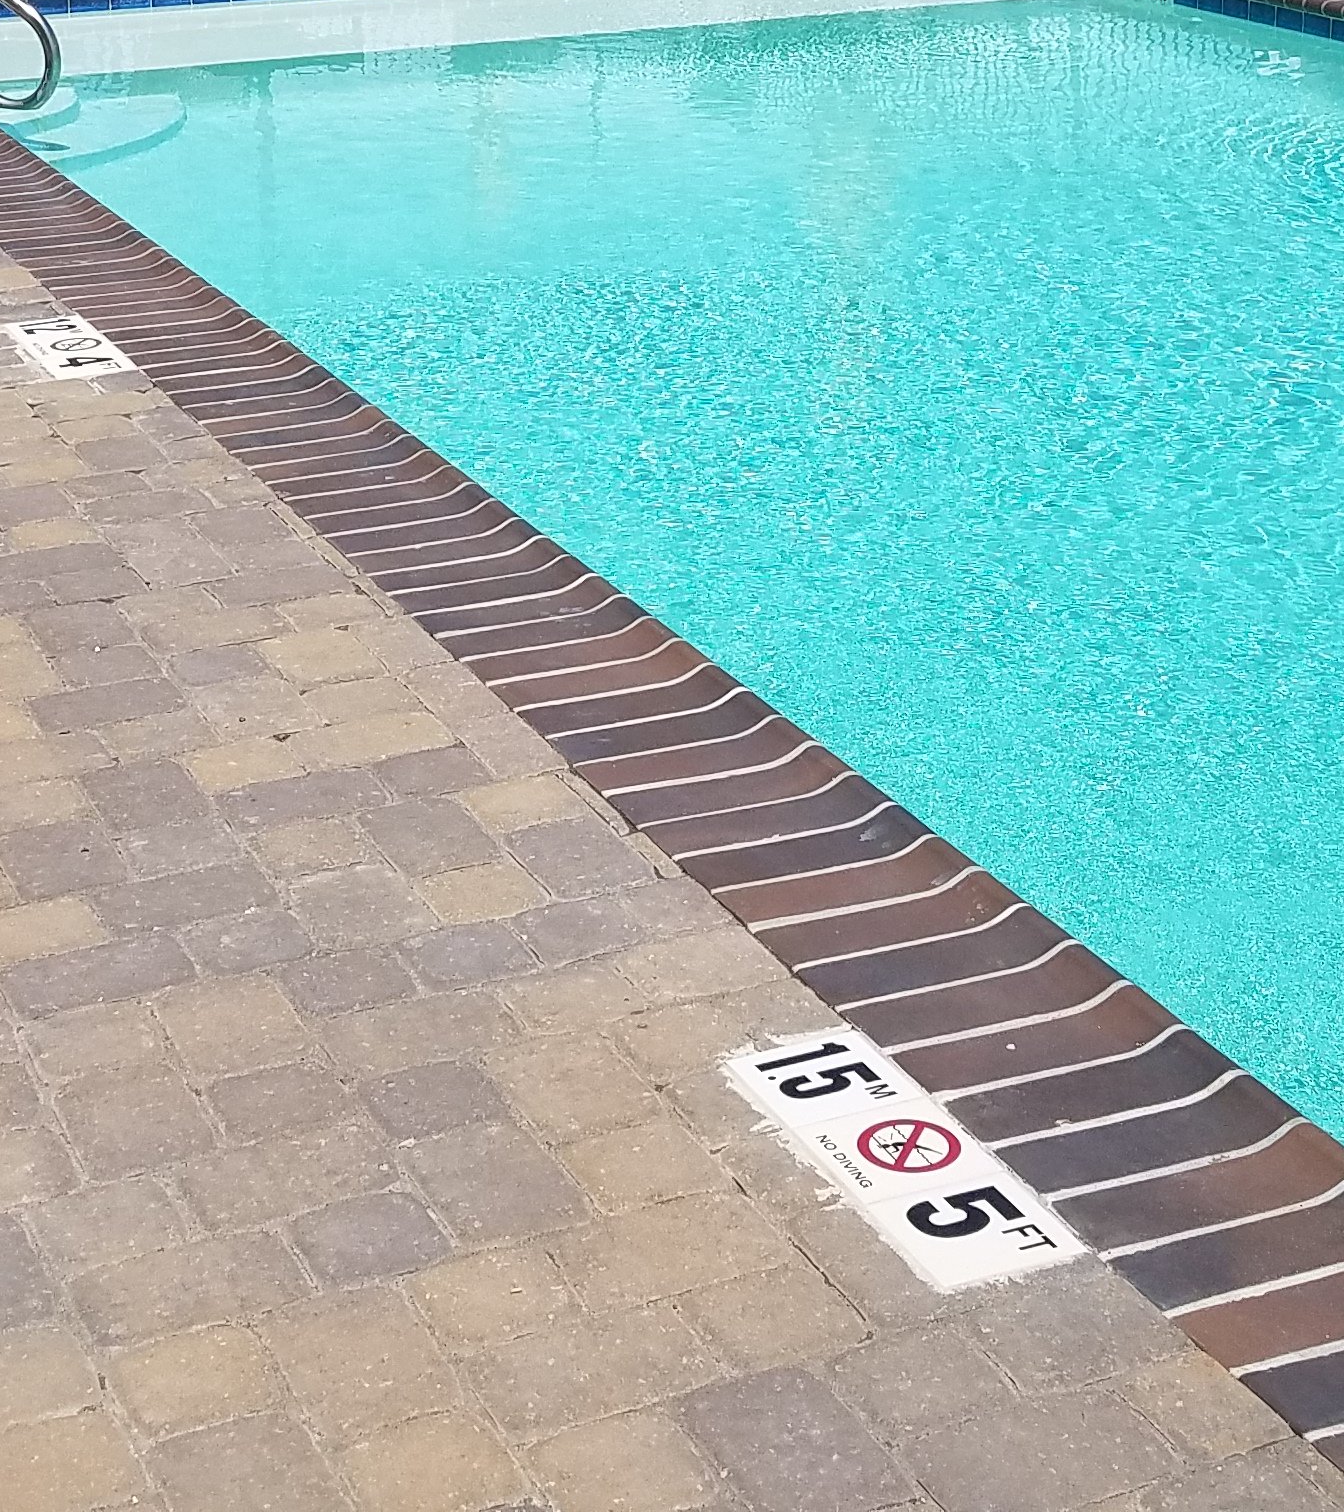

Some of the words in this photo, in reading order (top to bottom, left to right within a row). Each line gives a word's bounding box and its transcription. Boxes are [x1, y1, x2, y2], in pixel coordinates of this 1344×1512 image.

[59, 356, 114, 369] 4
[865, 1082, 899, 1100] M
[815, 1134, 838, 1151] NO
[833, 1150, 873, 1190] DIVING
[906, 1185, 1026, 1238] 5
[1001, 1223, 1058, 1251] FT
